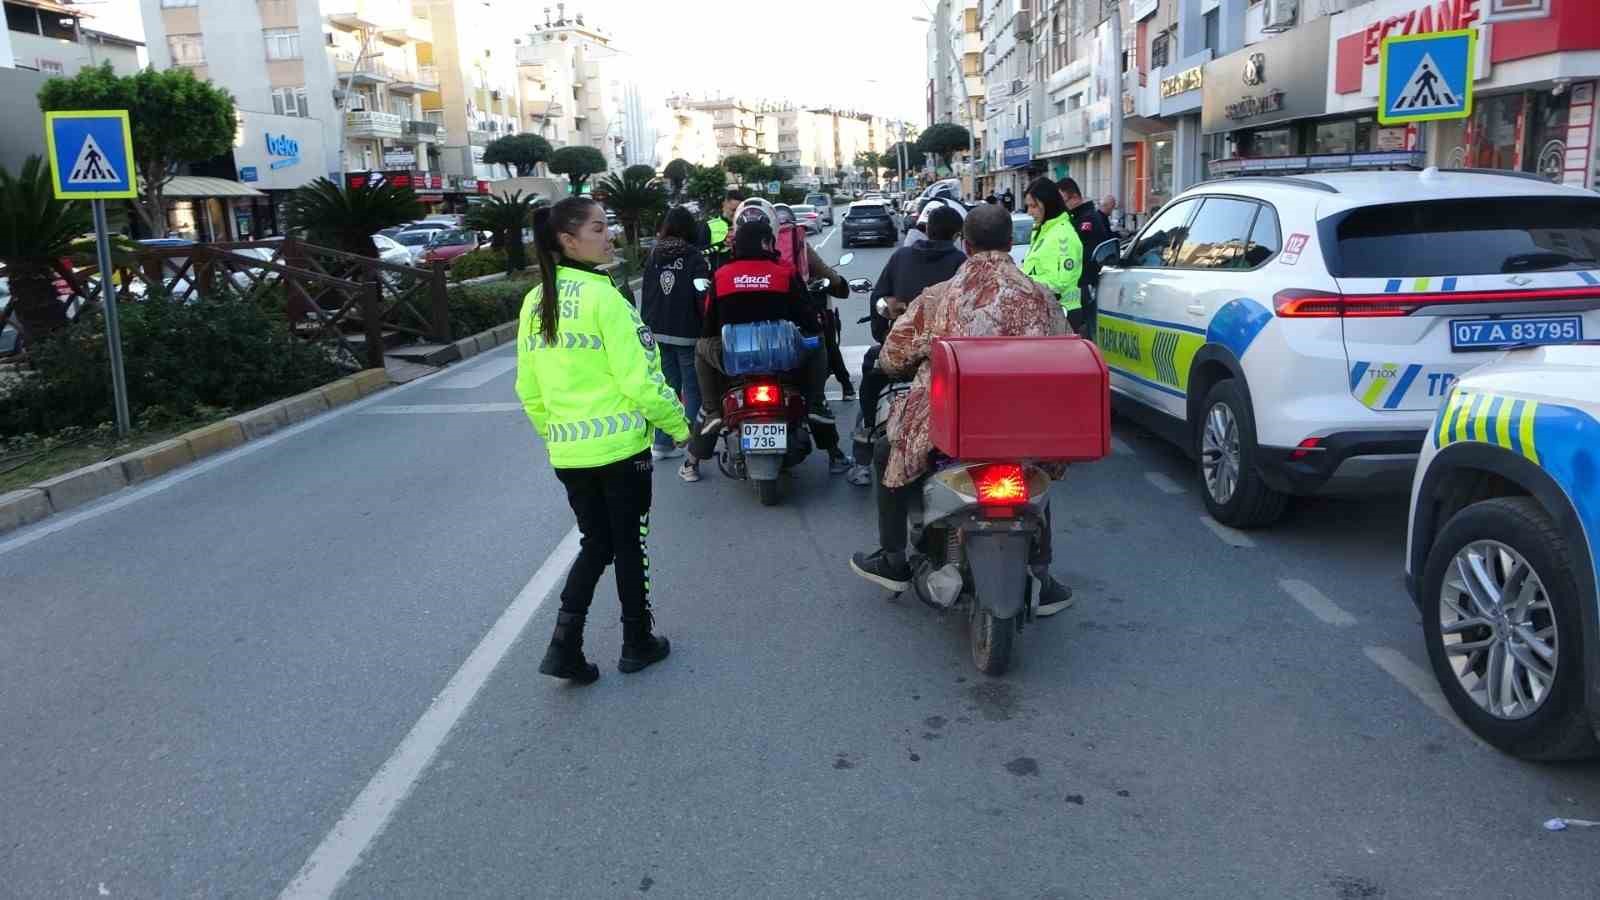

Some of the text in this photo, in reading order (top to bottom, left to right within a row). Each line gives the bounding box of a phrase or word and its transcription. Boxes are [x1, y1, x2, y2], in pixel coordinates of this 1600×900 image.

[265, 132, 299, 157] beko
[1287, 236, 1306, 252] 112
[1458, 322, 1575, 342] 07 A 83795
[1368, 369, 1397, 379] T10X
[744, 425, 785, 436] 07 CDH
[753, 437, 776, 447] 736
